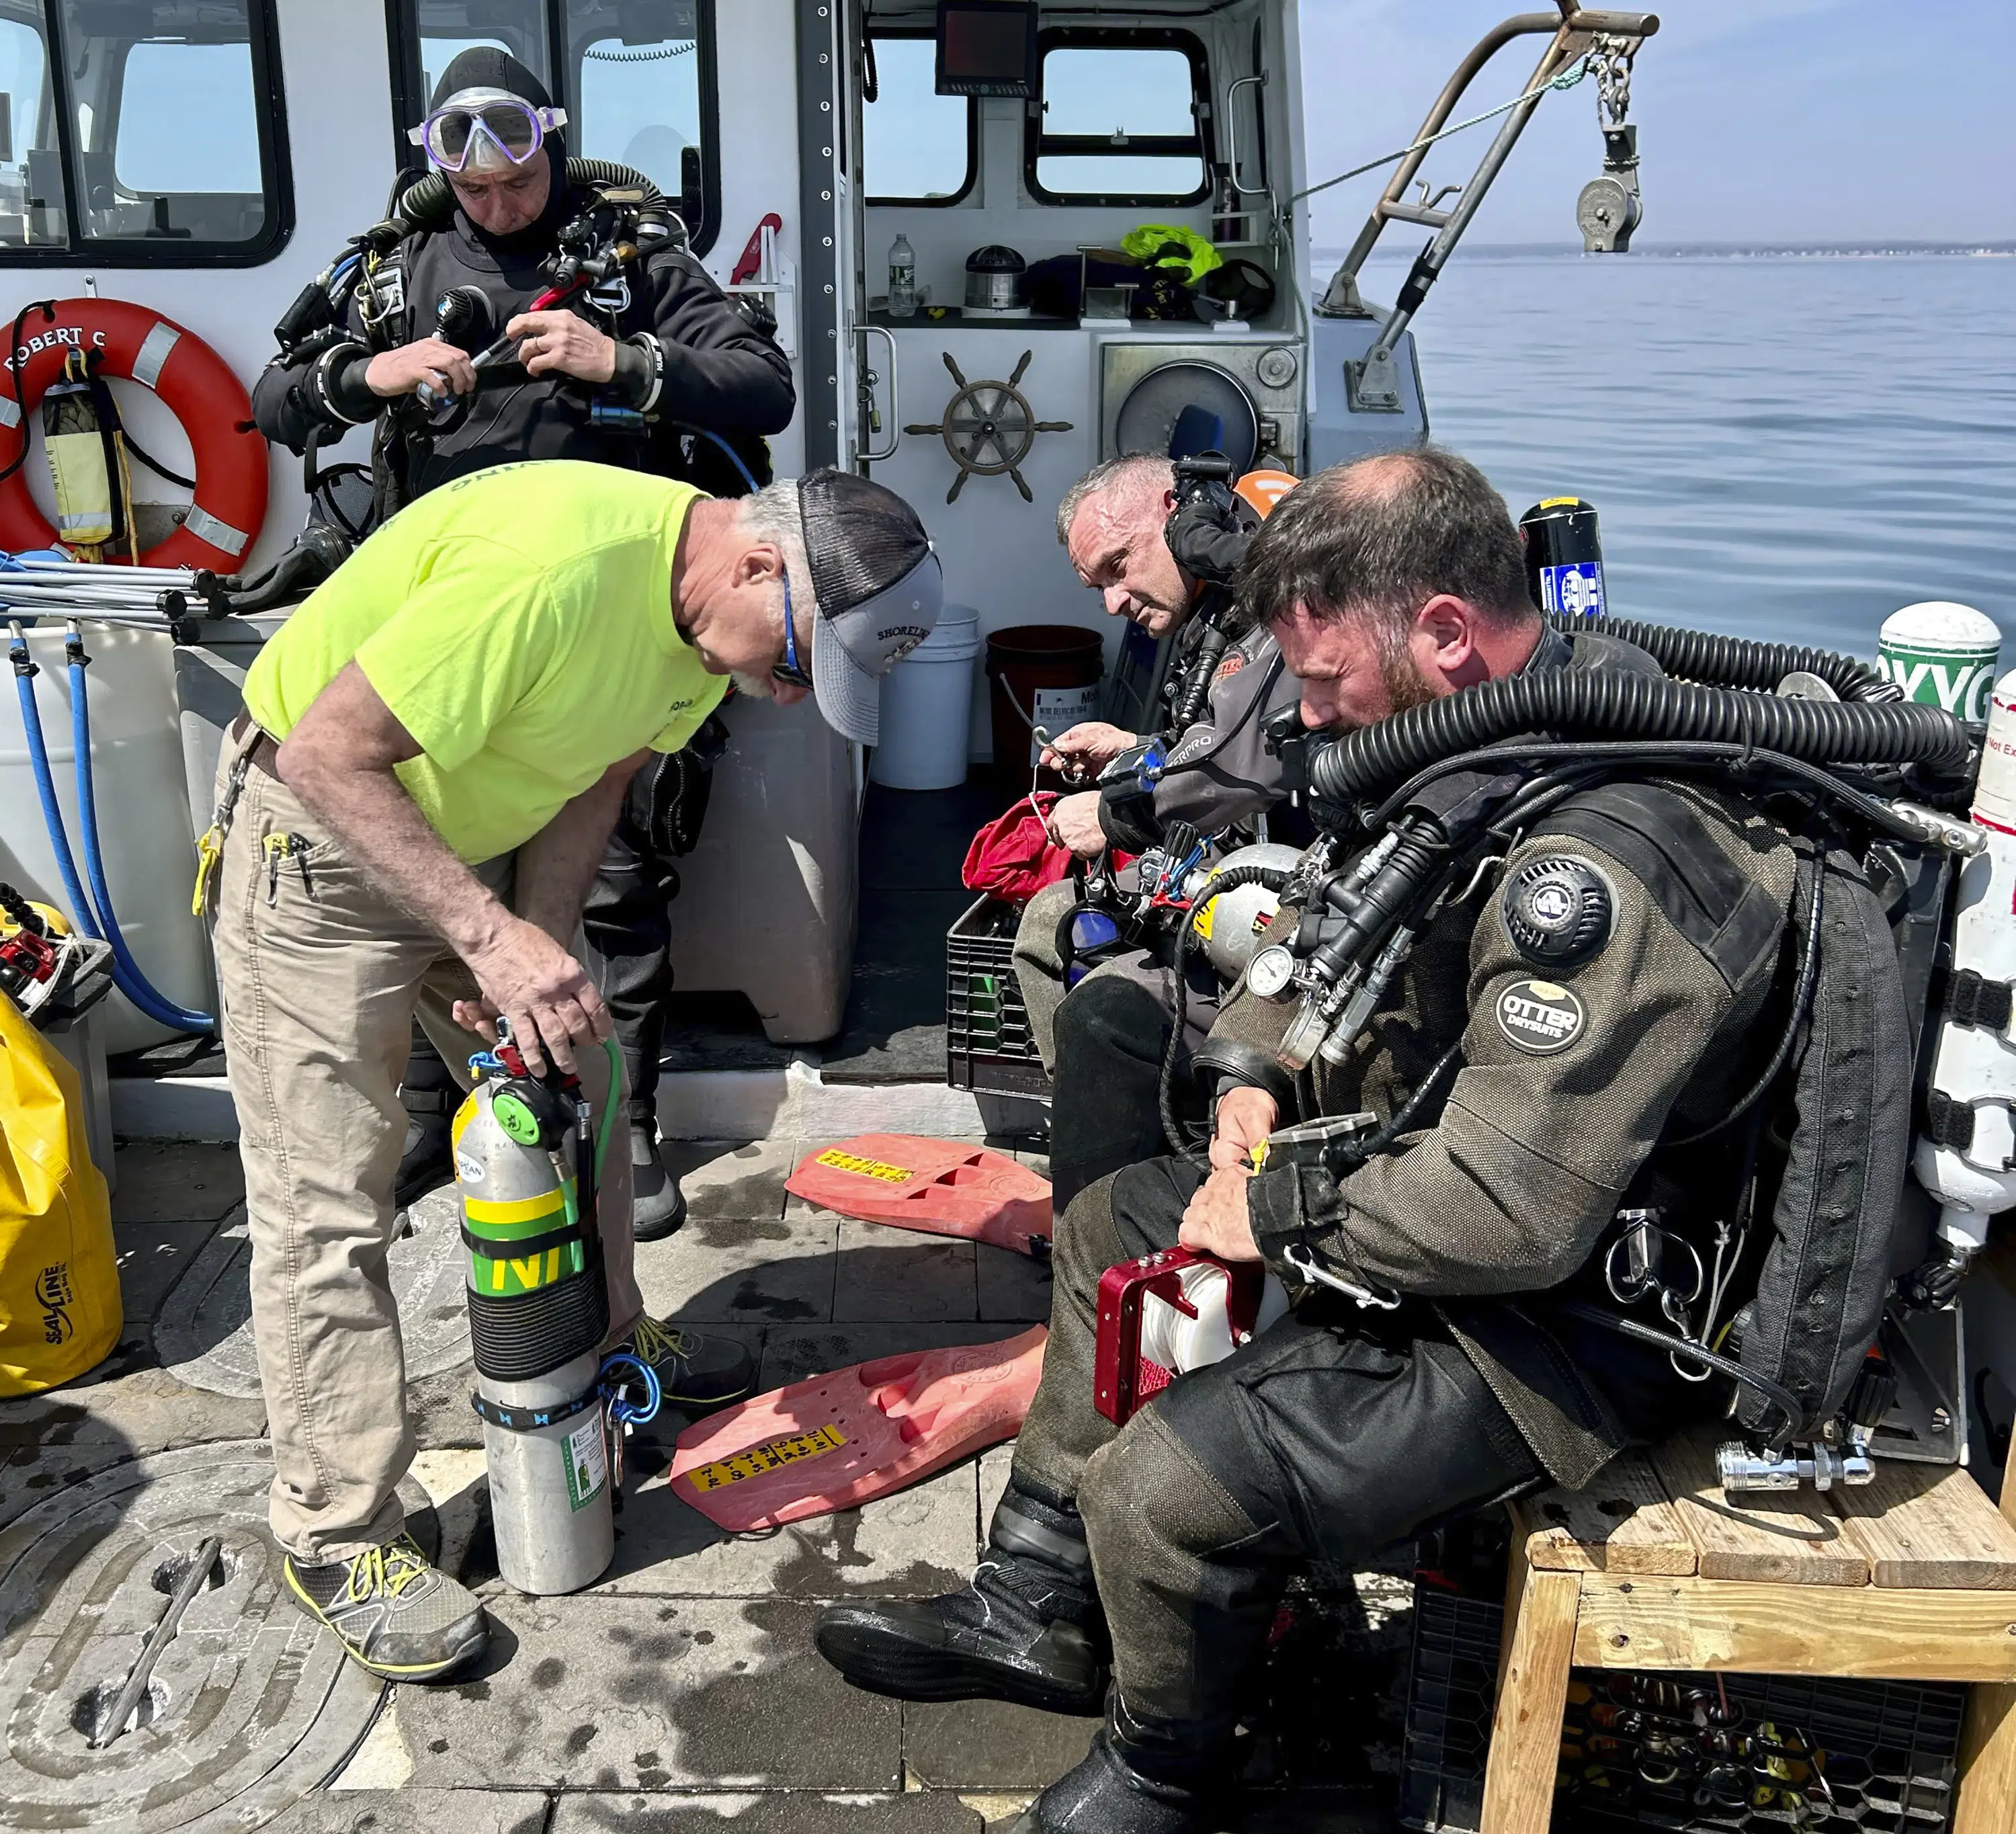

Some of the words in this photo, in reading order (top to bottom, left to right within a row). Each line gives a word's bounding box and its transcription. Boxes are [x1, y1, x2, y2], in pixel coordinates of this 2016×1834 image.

[93, 331, 106, 346] C
[1988, 737, 2001, 753] Not
[1503, 995, 1577, 1031] OTTER
[1507, 1013, 1564, 1038] DRYSUITS
[701, 1468, 720, 1488] 70-2
